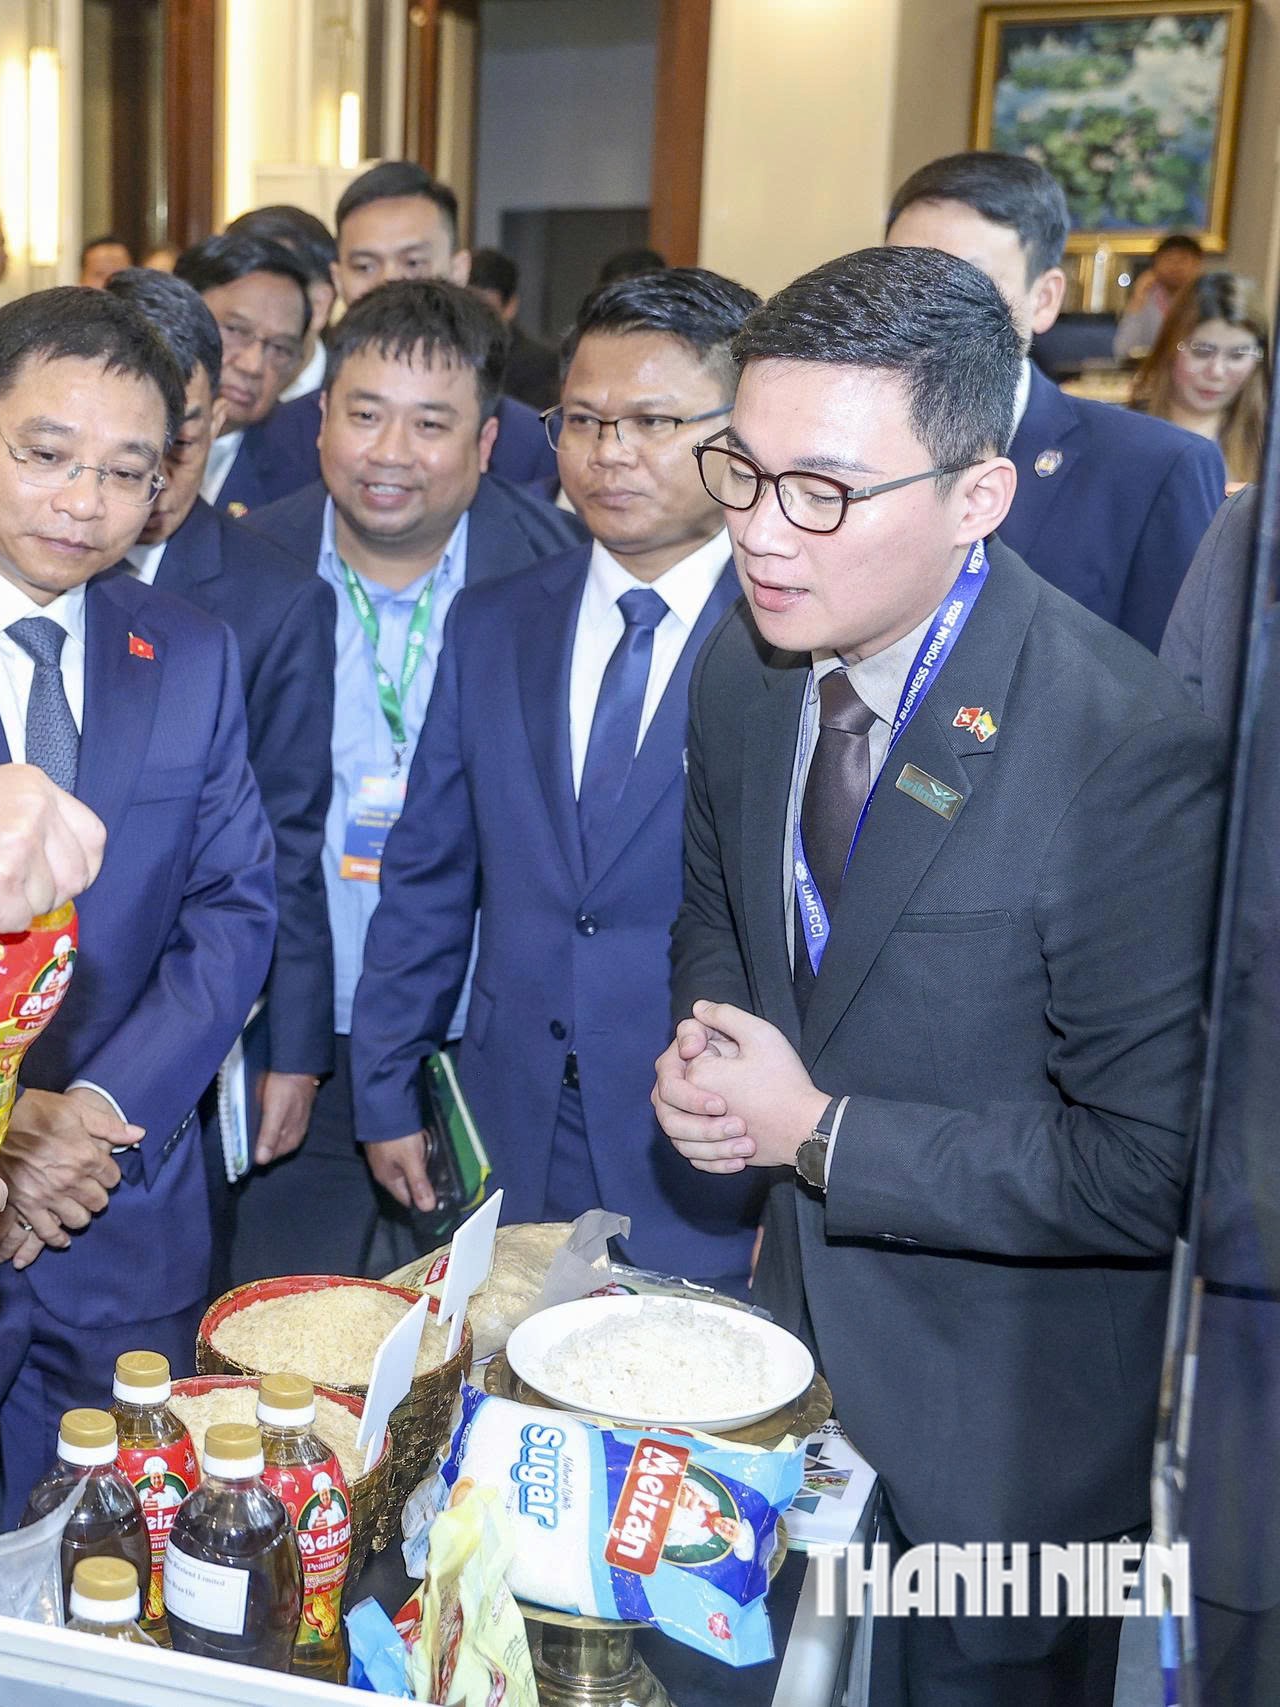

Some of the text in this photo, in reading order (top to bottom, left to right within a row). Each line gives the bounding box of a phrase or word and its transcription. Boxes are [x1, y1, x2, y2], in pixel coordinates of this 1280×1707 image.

[899, 599, 964, 722] BUSINESS FORUM 2026
[801, 883, 824, 938] UMFCCI
[512, 1423, 566, 1530] Sugar
[616, 1446, 681, 1559] Meizan
[298, 1522, 351, 1555] Meizan
[307, 1559, 335, 1572] Peanut
